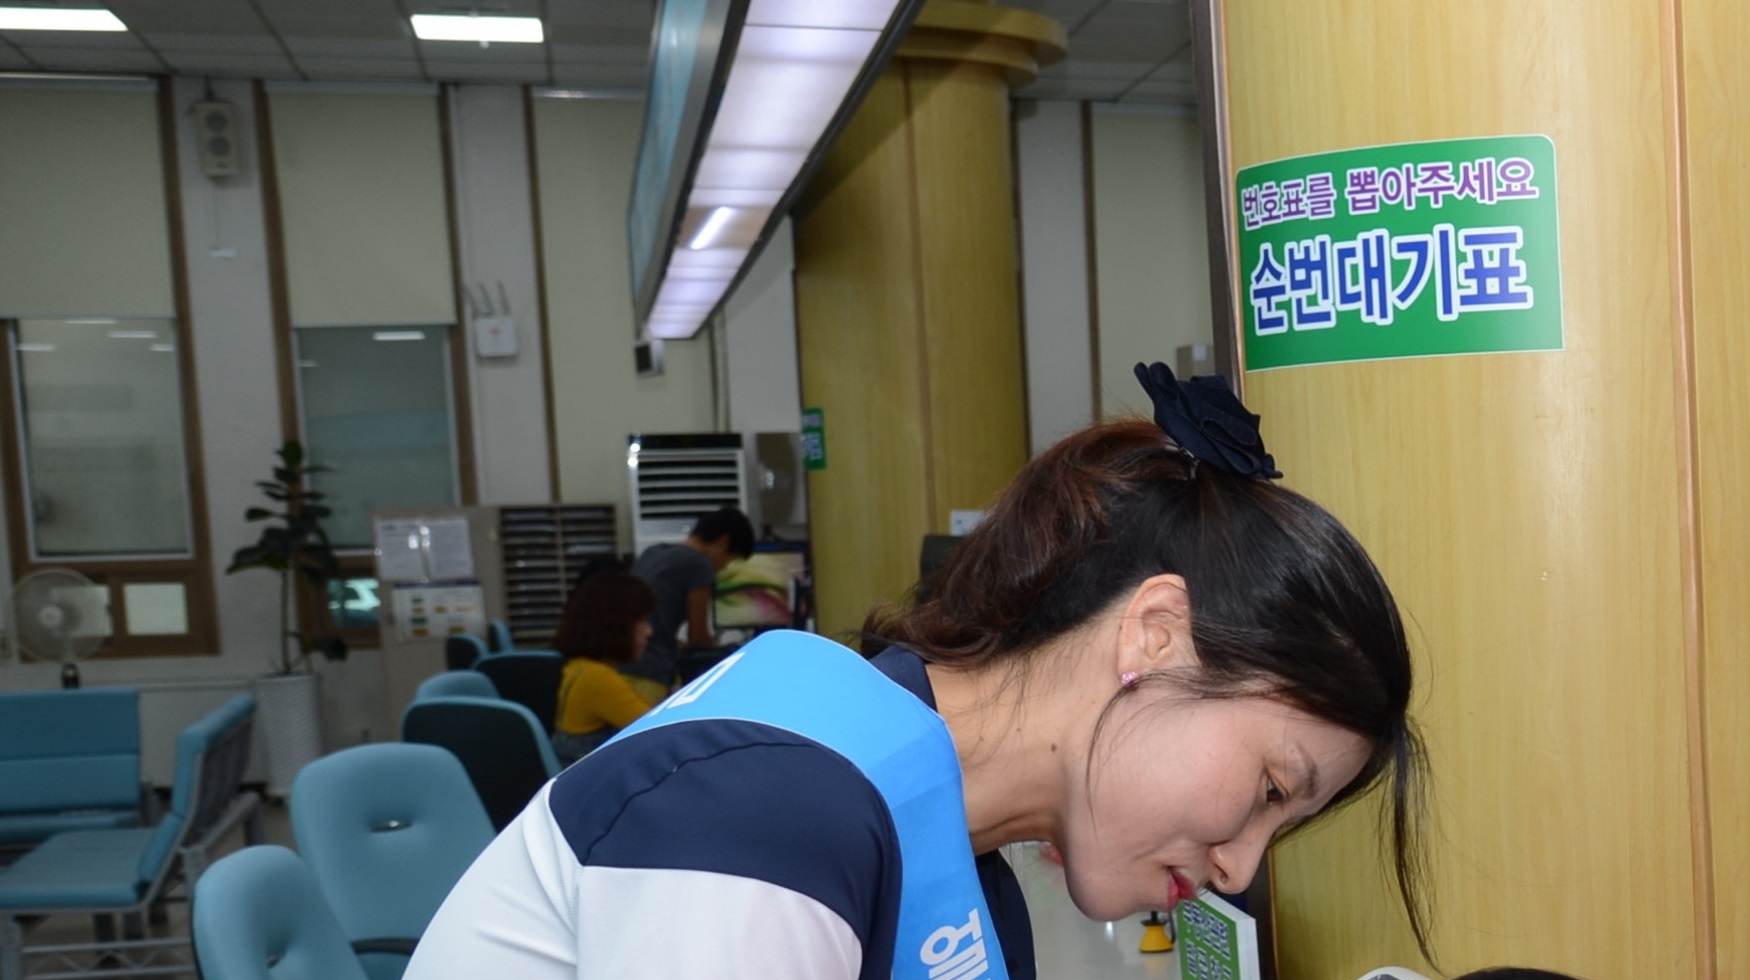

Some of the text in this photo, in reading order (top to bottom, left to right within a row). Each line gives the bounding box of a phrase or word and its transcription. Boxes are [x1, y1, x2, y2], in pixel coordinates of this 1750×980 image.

[1241, 157, 1539, 230] 번호표를 뽑아주세요
[1250, 223, 1533, 336] 순번대기표
